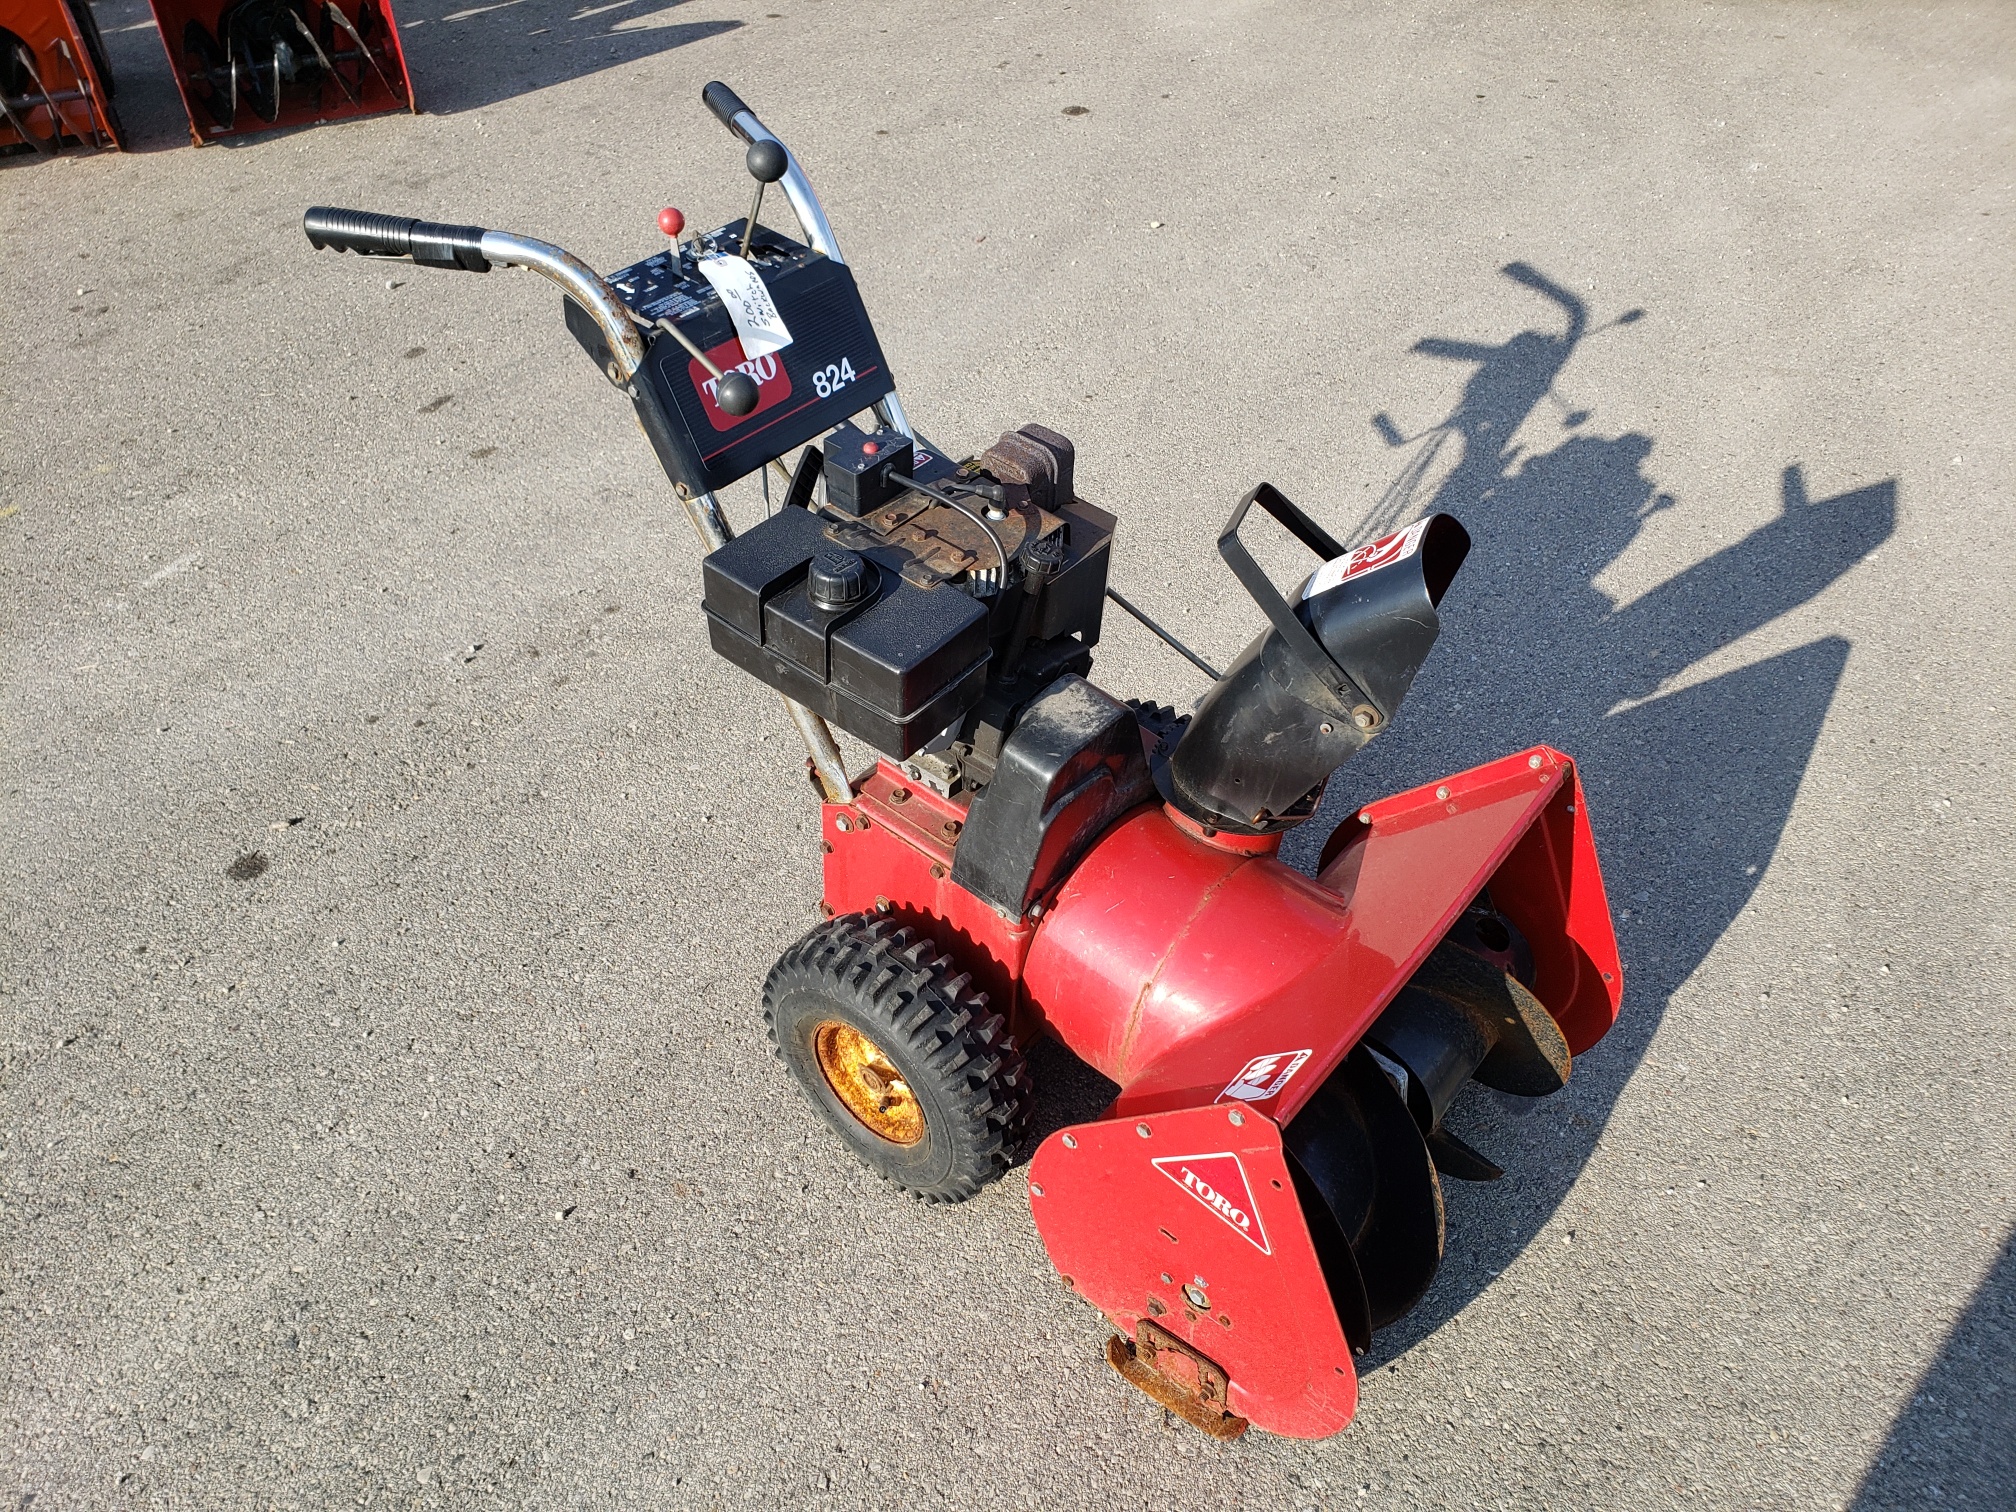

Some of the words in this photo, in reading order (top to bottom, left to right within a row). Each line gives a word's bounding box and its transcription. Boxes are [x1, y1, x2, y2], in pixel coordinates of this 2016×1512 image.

[743, 301, 760, 327] 200
[702, 354, 776, 407] TRO
[812, 357, 856, 398] 824
[1265, 1062, 1300, 1097] DANGER
[1180, 1167, 1249, 1231] TORO
